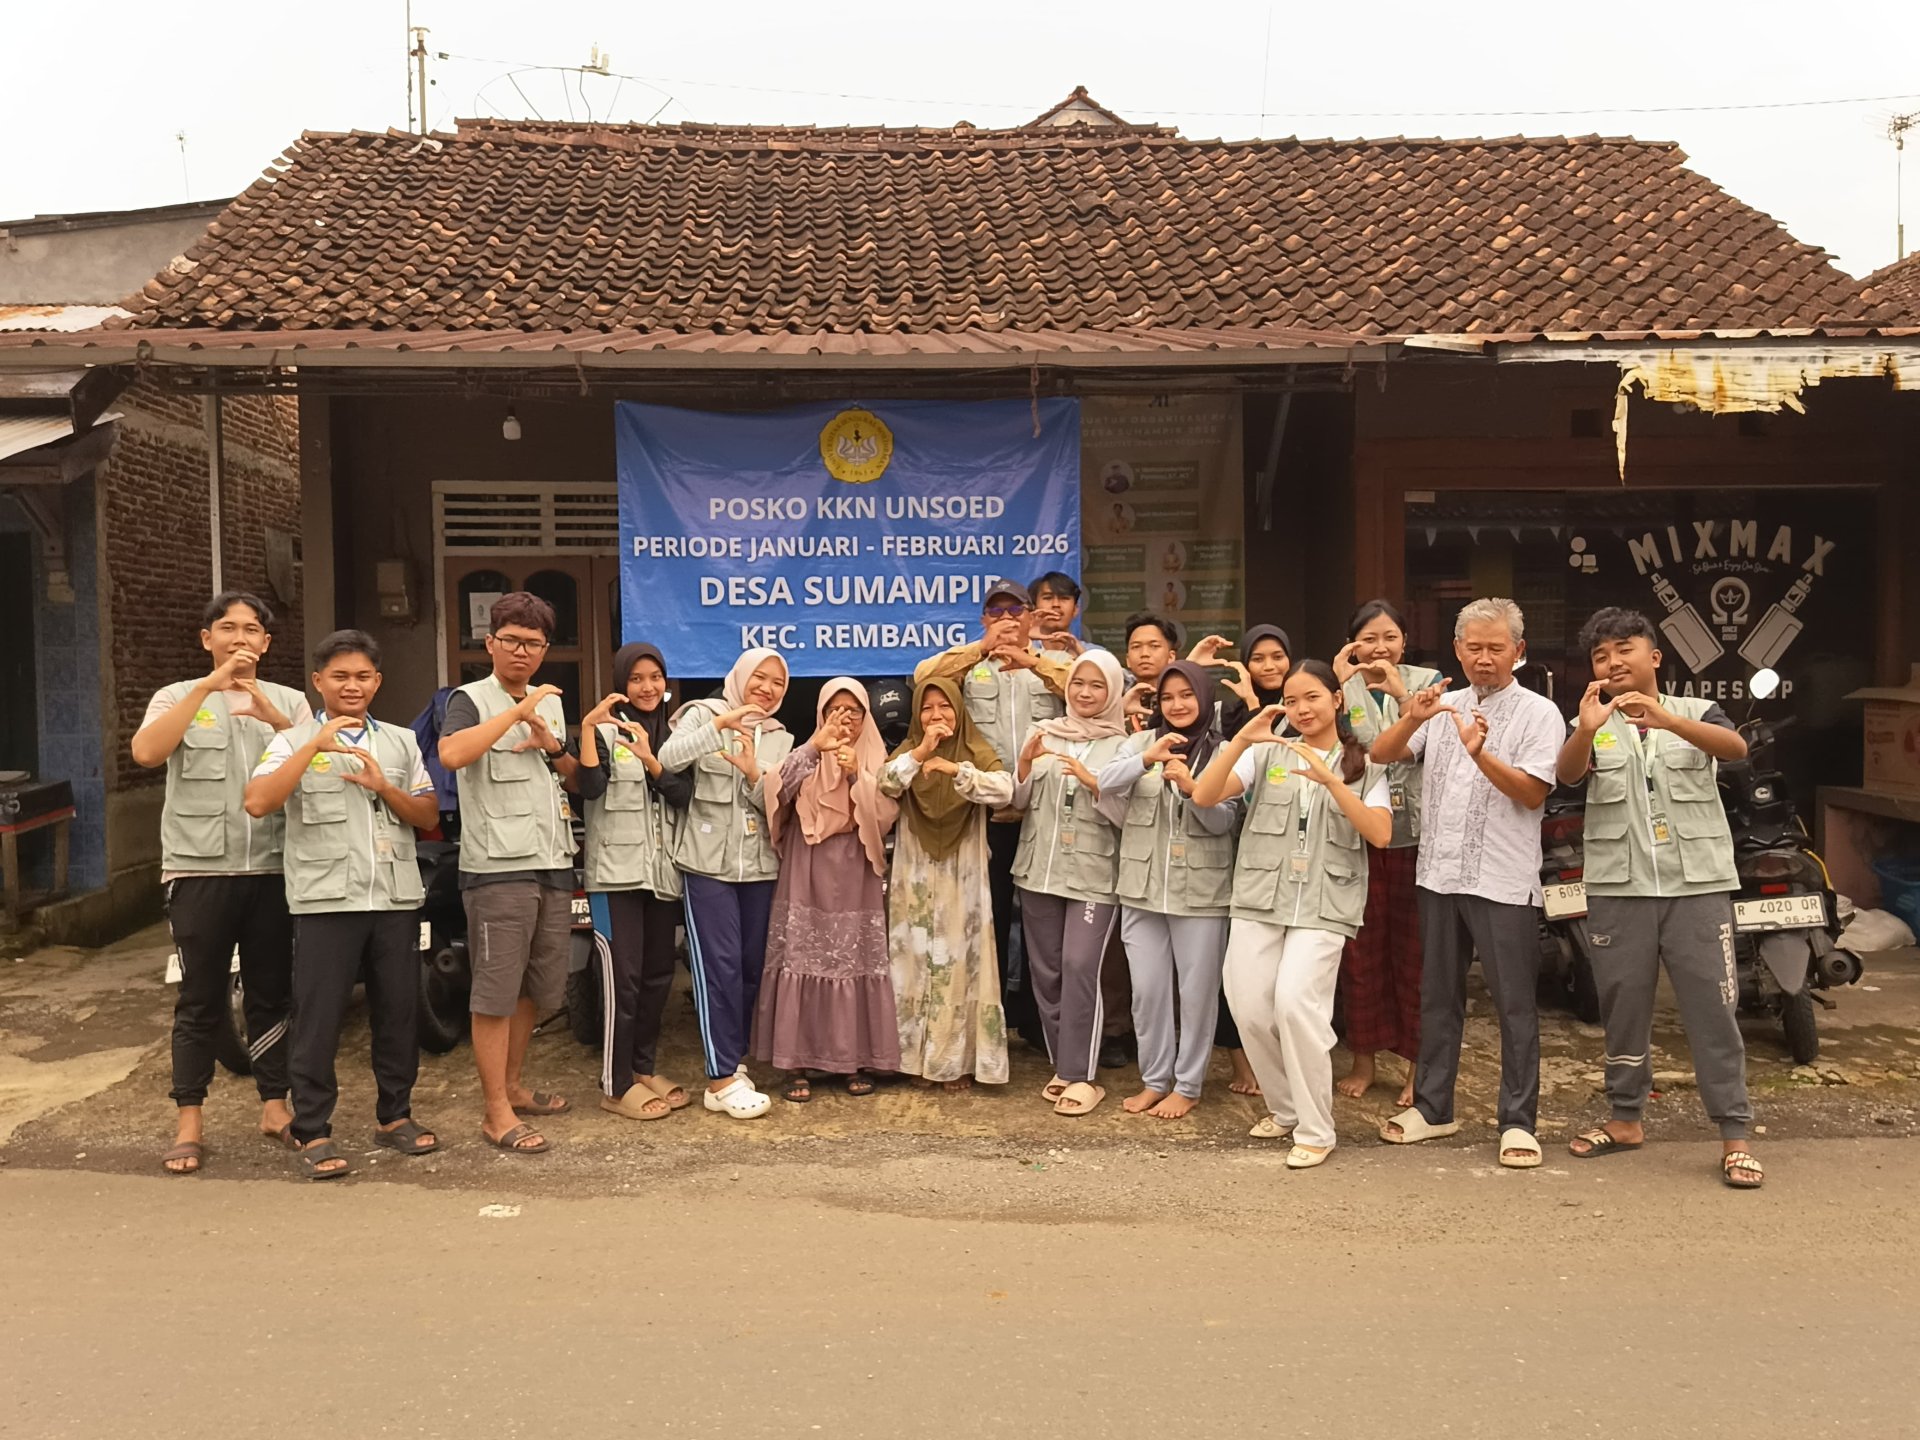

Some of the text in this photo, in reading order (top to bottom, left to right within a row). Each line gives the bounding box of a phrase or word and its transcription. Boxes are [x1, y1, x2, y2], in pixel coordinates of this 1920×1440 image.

[709, 495, 1005, 520] POSKO KKN UNSOED
[633, 536, 743, 557] PERIODE
[747, 536, 859, 562] JANUARI
[882, 535, 1004, 556] FEBRUARI
[1012, 533, 1069, 555] 2026
[1627, 519, 1836, 577] MIXMAX
[700, 576, 795, 606] DESA
[741, 623, 967, 649] KEC. REMBANG
[1665, 680, 1793, 699] VAPESP
[1738, 905, 1745, 916] R
[1759, 900, 1793, 913] 4020
